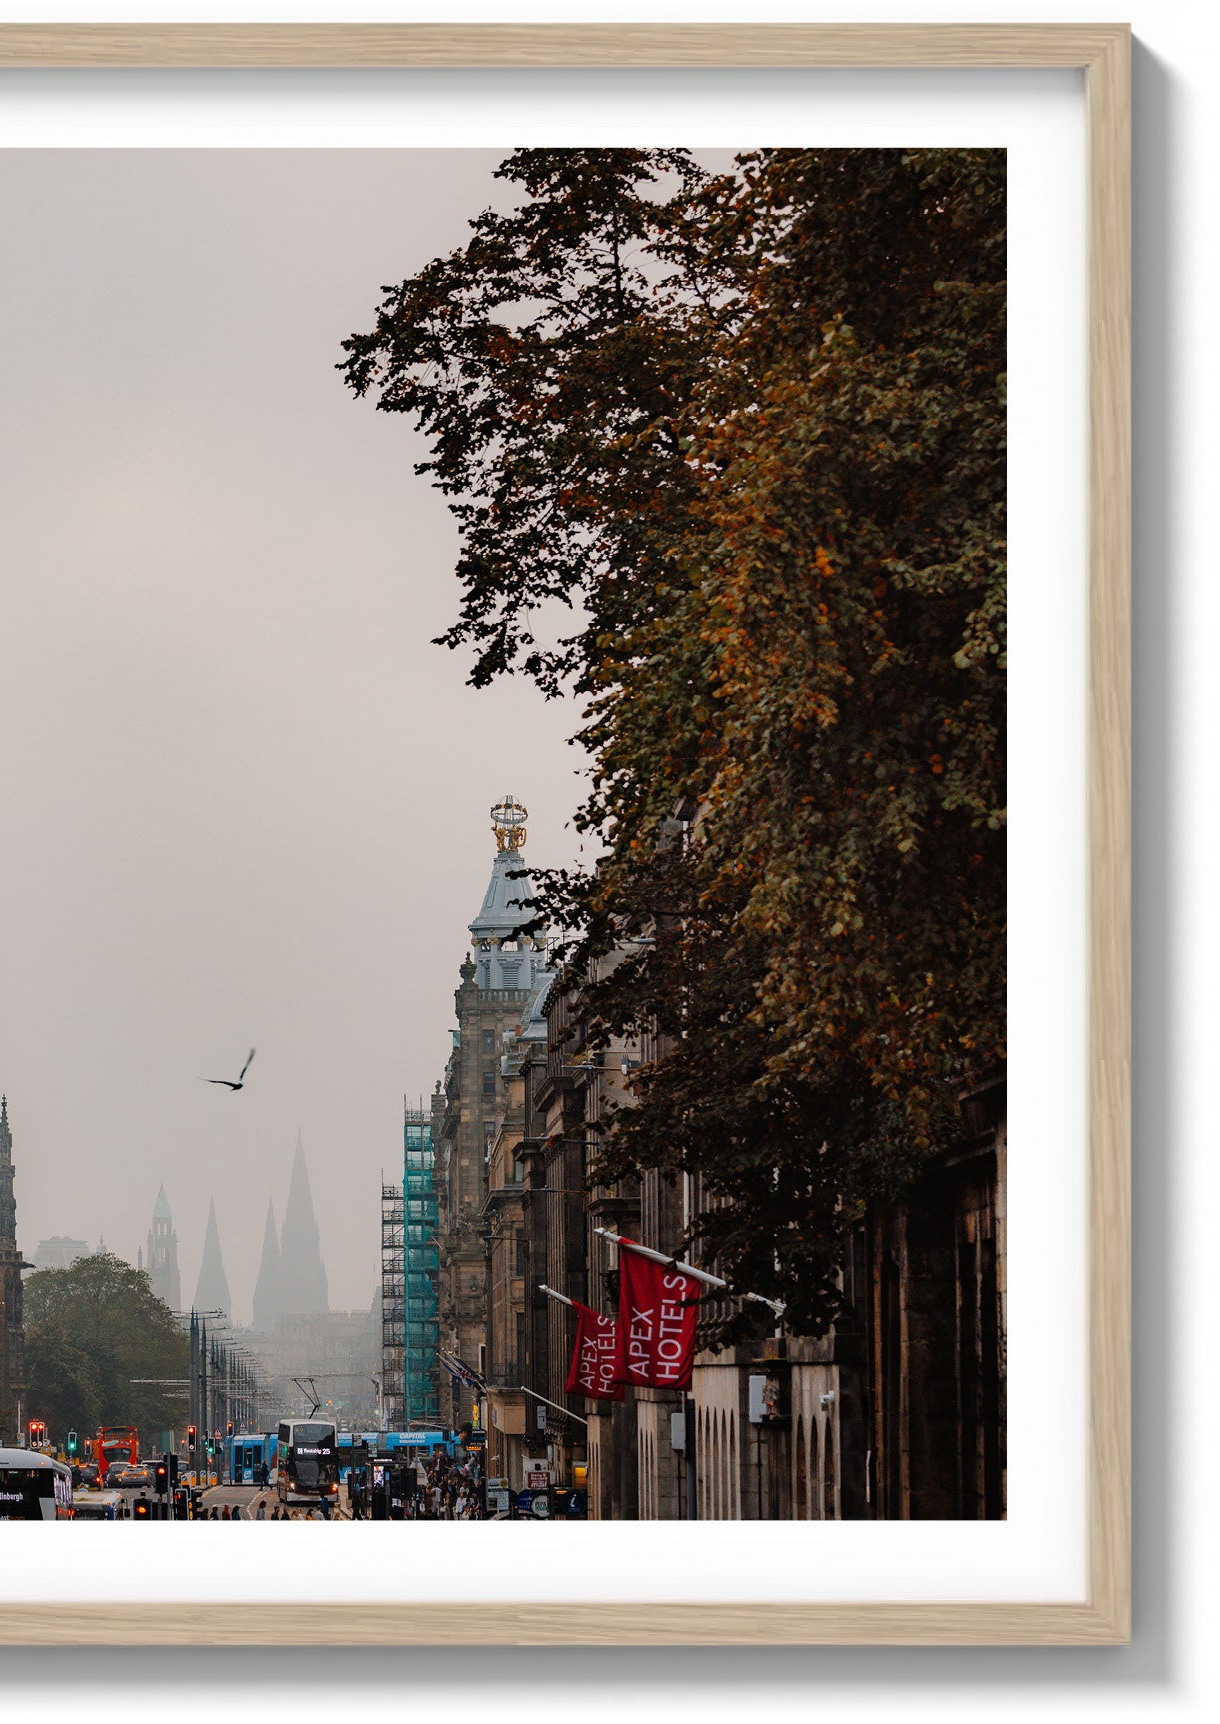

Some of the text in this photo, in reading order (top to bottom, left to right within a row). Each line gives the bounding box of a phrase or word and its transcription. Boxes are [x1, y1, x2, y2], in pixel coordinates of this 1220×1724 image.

[628, 1307, 654, 1377] APEX
[656, 1275, 687, 1379] HOTELS
[579, 1336, 597, 1389] APEX
